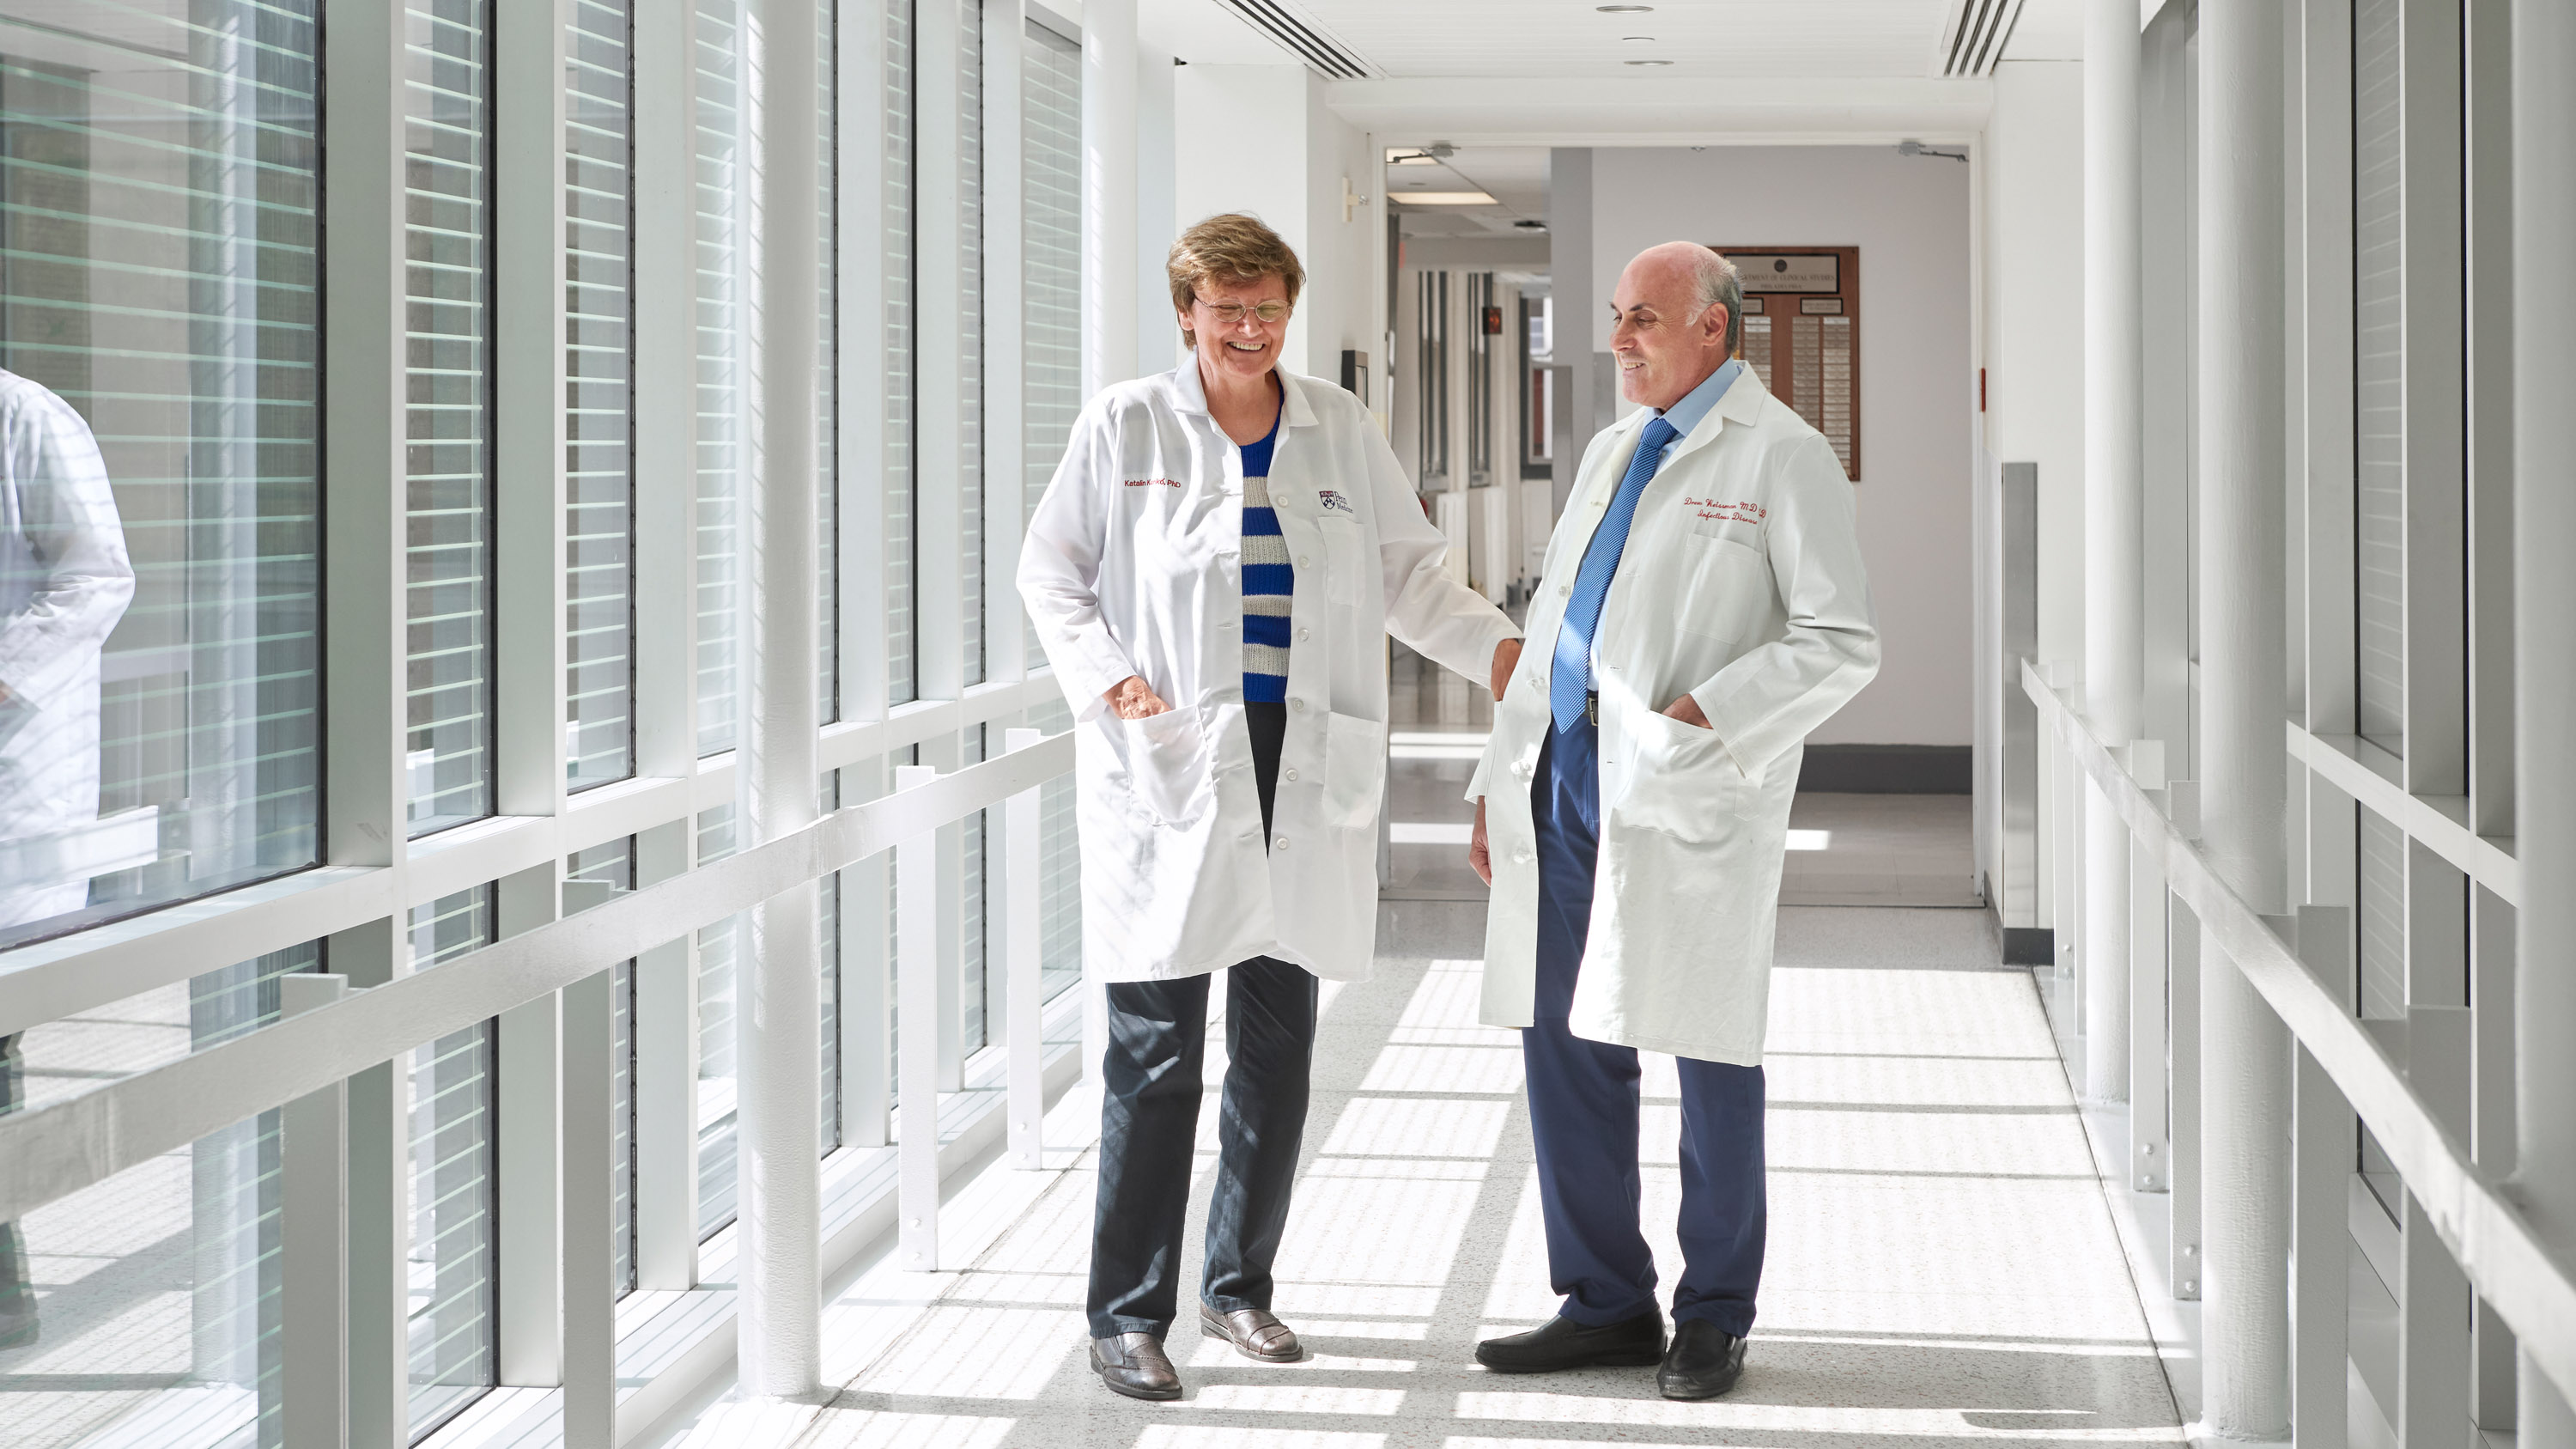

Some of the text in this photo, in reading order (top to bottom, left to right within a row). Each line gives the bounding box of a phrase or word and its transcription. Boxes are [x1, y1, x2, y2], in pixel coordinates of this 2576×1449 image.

[1167, 478, 1182, 488] PhD
[1684, 496, 1703, 505] Drew
[1697, 508, 1730, 521] Infectious
